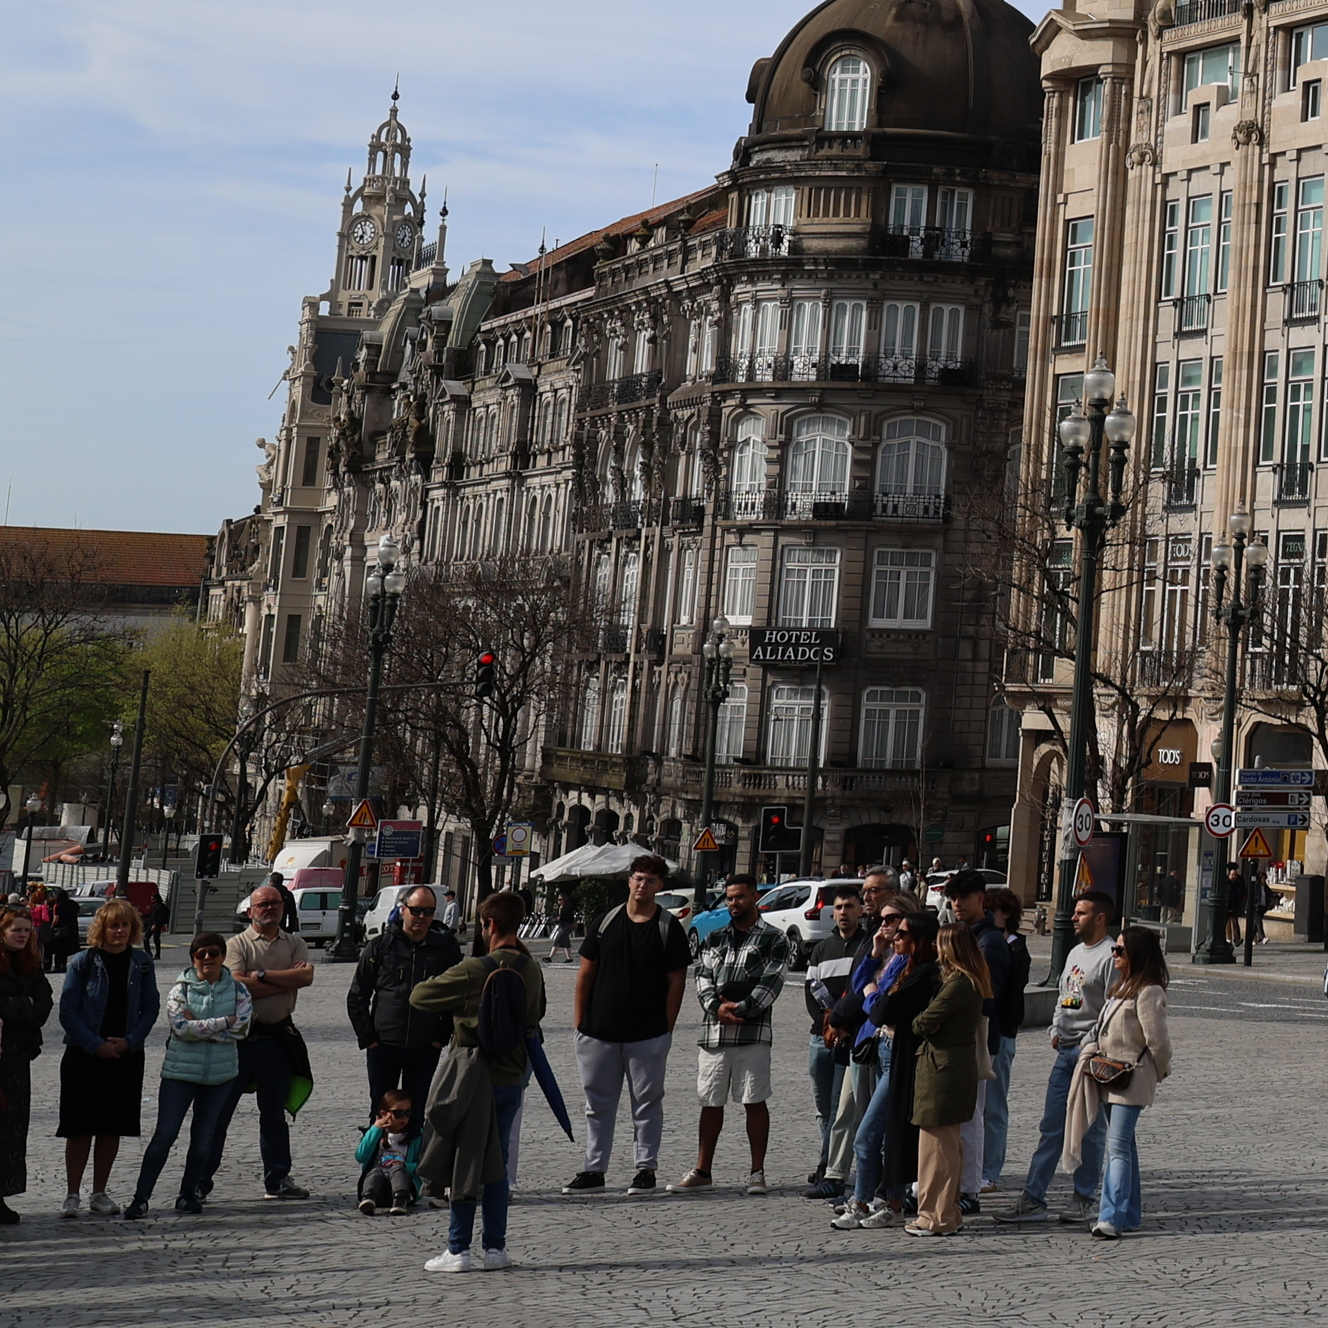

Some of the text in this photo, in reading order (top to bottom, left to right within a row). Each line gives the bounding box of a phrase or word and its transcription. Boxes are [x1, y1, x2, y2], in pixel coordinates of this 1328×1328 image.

[764, 630, 820, 644] HOTEL
[752, 646, 834, 661] ALIADOS
[1077, 813, 1092, 833] 30
[1210, 814, 1232, 828] 30
